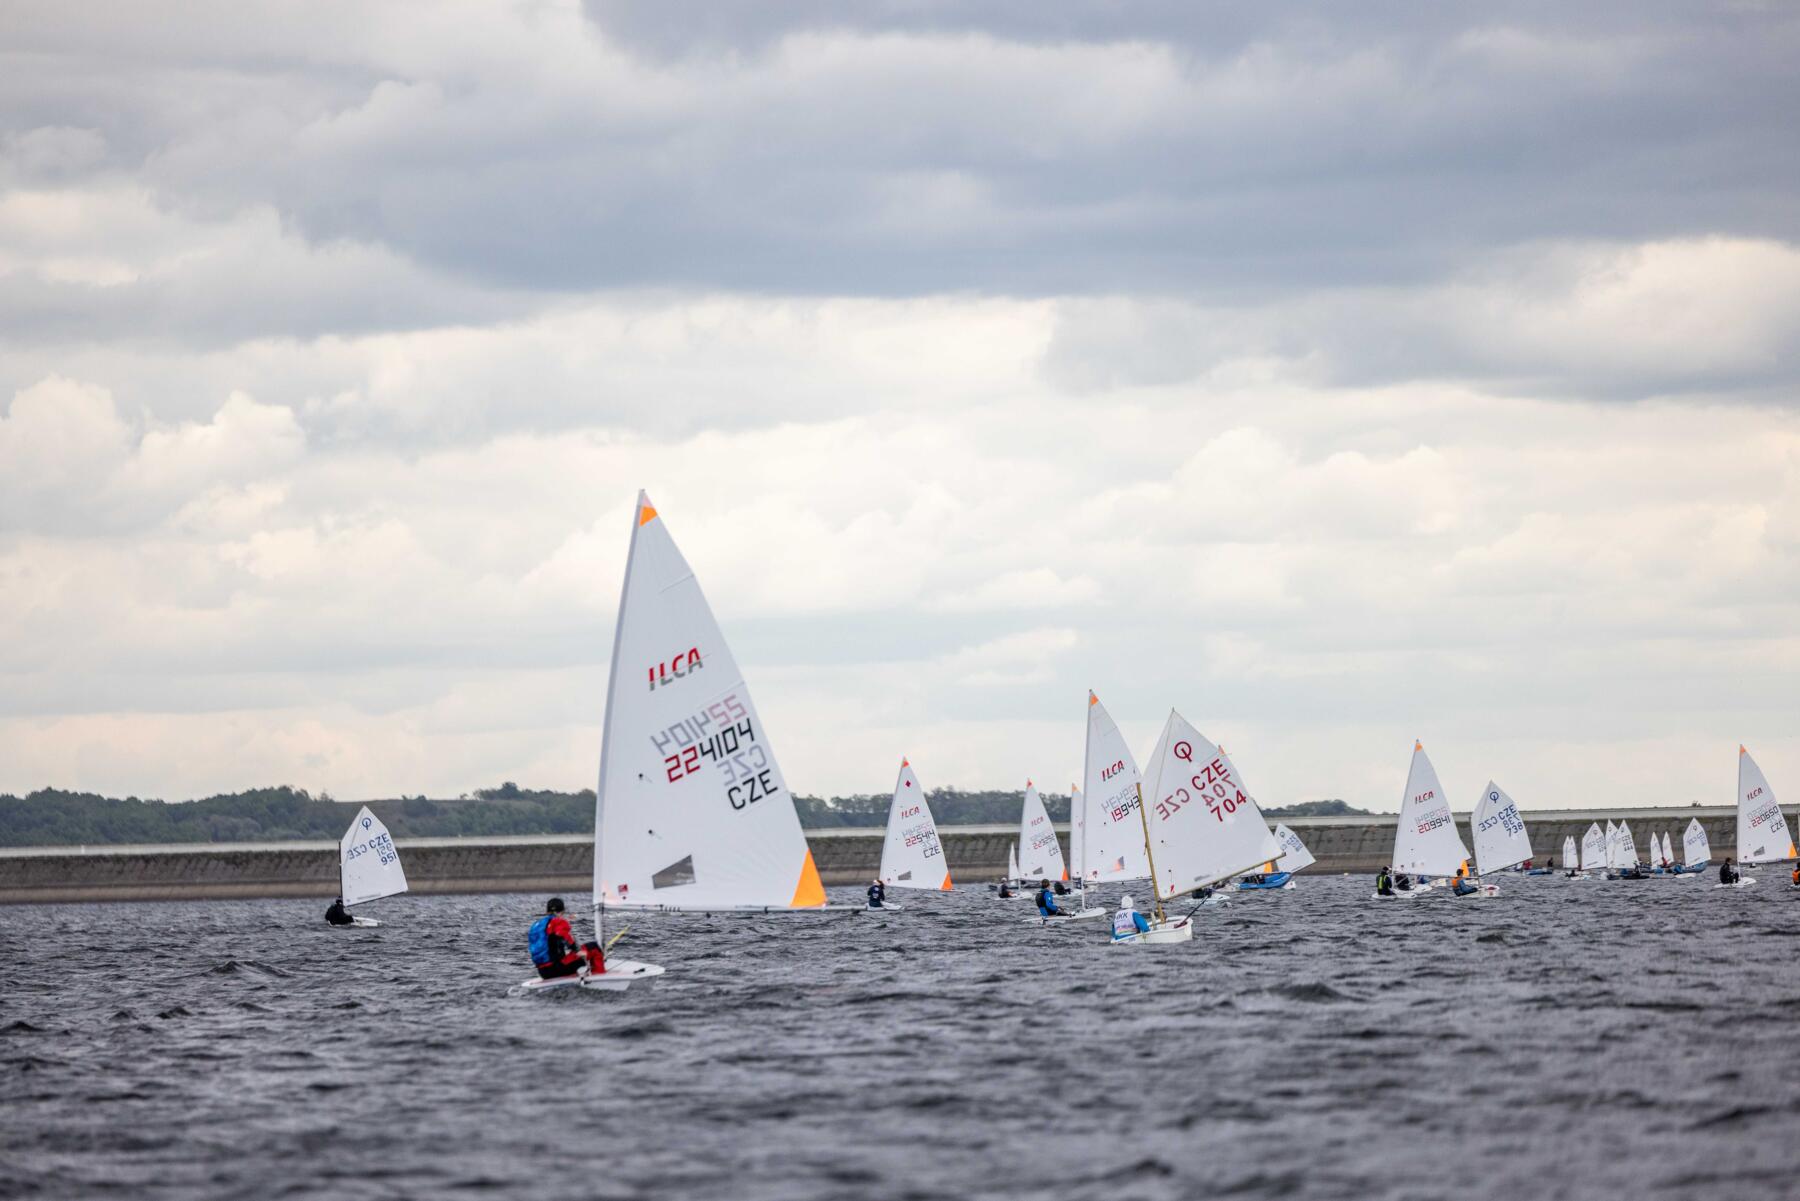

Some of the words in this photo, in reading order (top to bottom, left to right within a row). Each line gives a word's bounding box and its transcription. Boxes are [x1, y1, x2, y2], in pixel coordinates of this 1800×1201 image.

[648, 647, 703, 691] ILCA
[664, 717, 755, 783] 224104
[1102, 760, 1124, 781] ILCA
[1191, 758, 1227, 791] CZE
[727, 768, 778, 810] CZE
[1415, 791, 1434, 804] ILCA
[1747, 787, 1763, 800] ILCA
[901, 806, 920, 820] ILCA
[1111, 795, 1140, 822] 19943
[1210, 789, 1247, 822] 704
[1498, 804, 1517, 821] CZE
[1418, 815, 1451, 833] 209941
[1506, 823, 1523, 838] 738
[1770, 820, 1784, 833] CZE
[369, 833, 389, 849] CZE
[381, 851, 397, 865] 951
[923, 845, 940, 858] CZE
